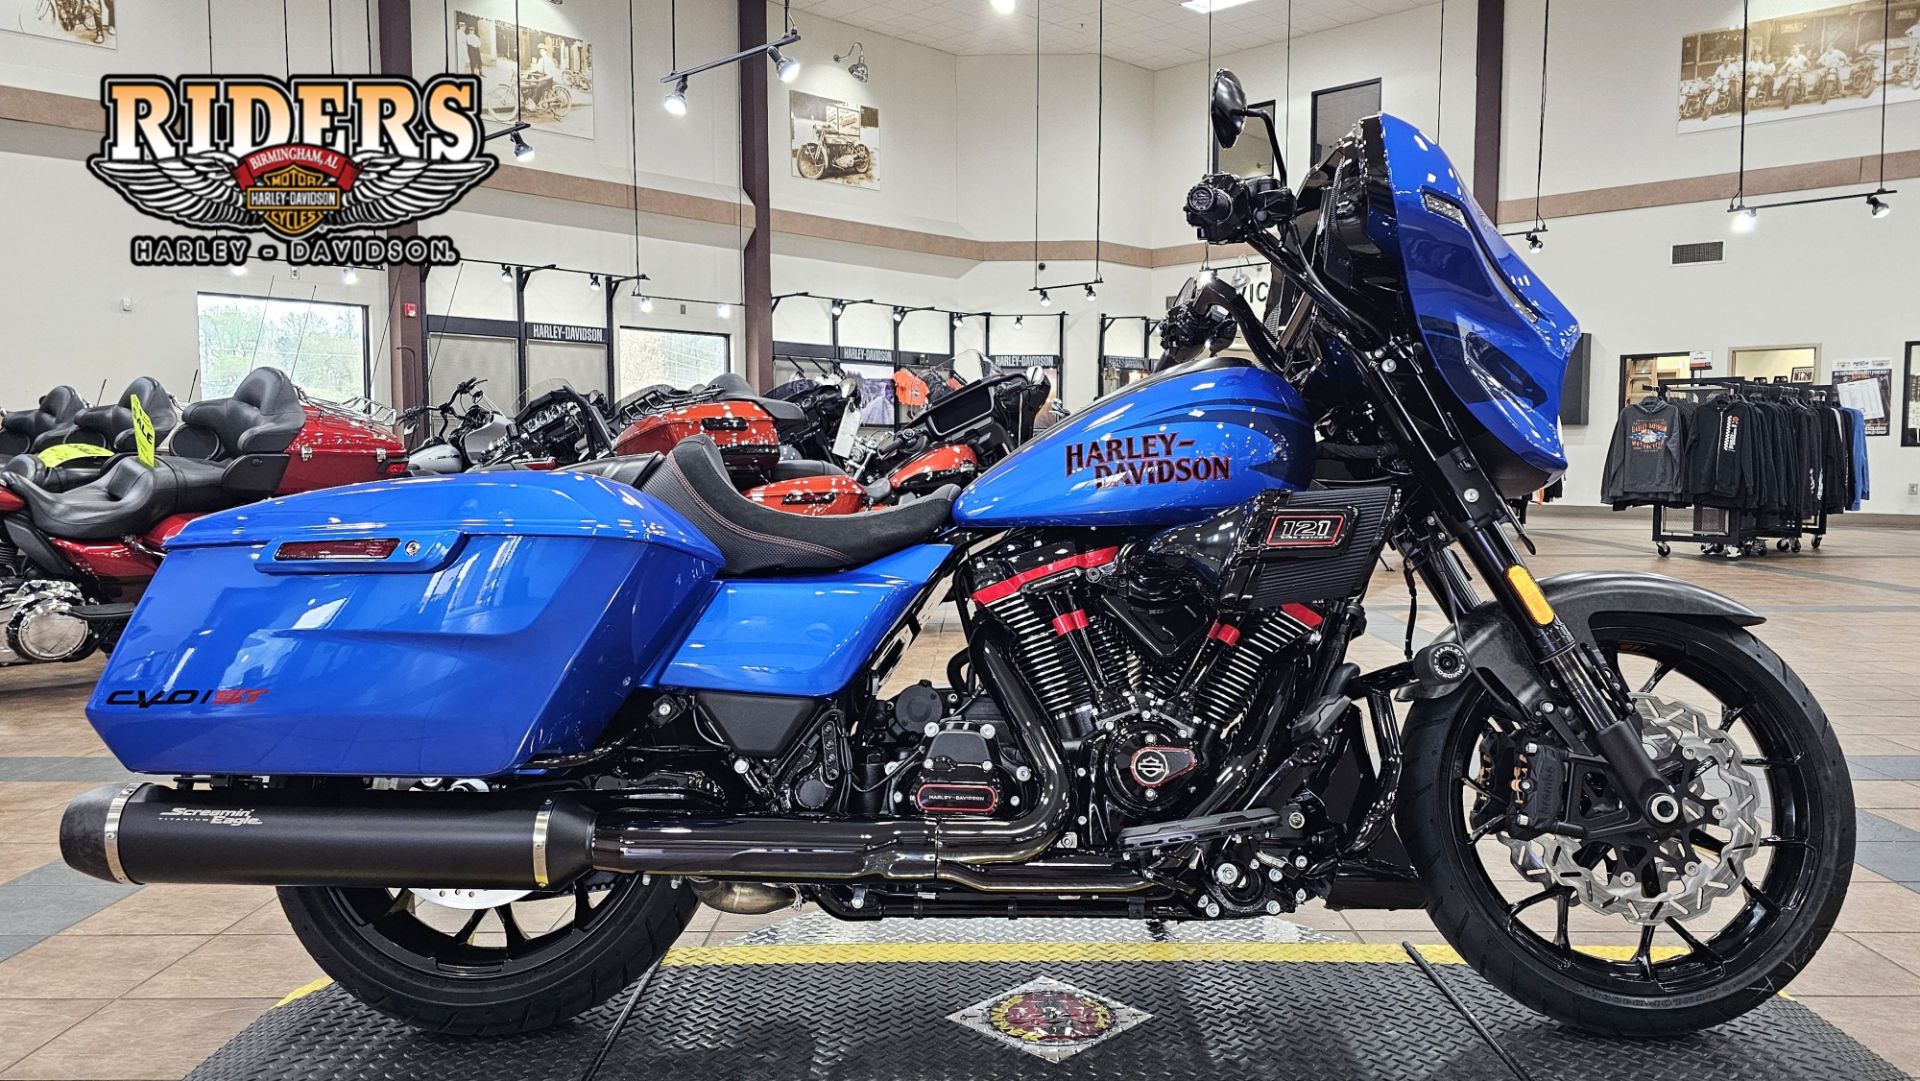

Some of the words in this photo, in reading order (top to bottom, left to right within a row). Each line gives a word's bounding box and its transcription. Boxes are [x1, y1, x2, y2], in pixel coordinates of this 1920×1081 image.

[533, 323, 603, 342] HARLEY-DAVIDSON
[1066, 432, 1195, 477] HARLEY-
[1094, 456, 1232, 489] DAVIDSON
[1282, 520, 1331, 536] 121
